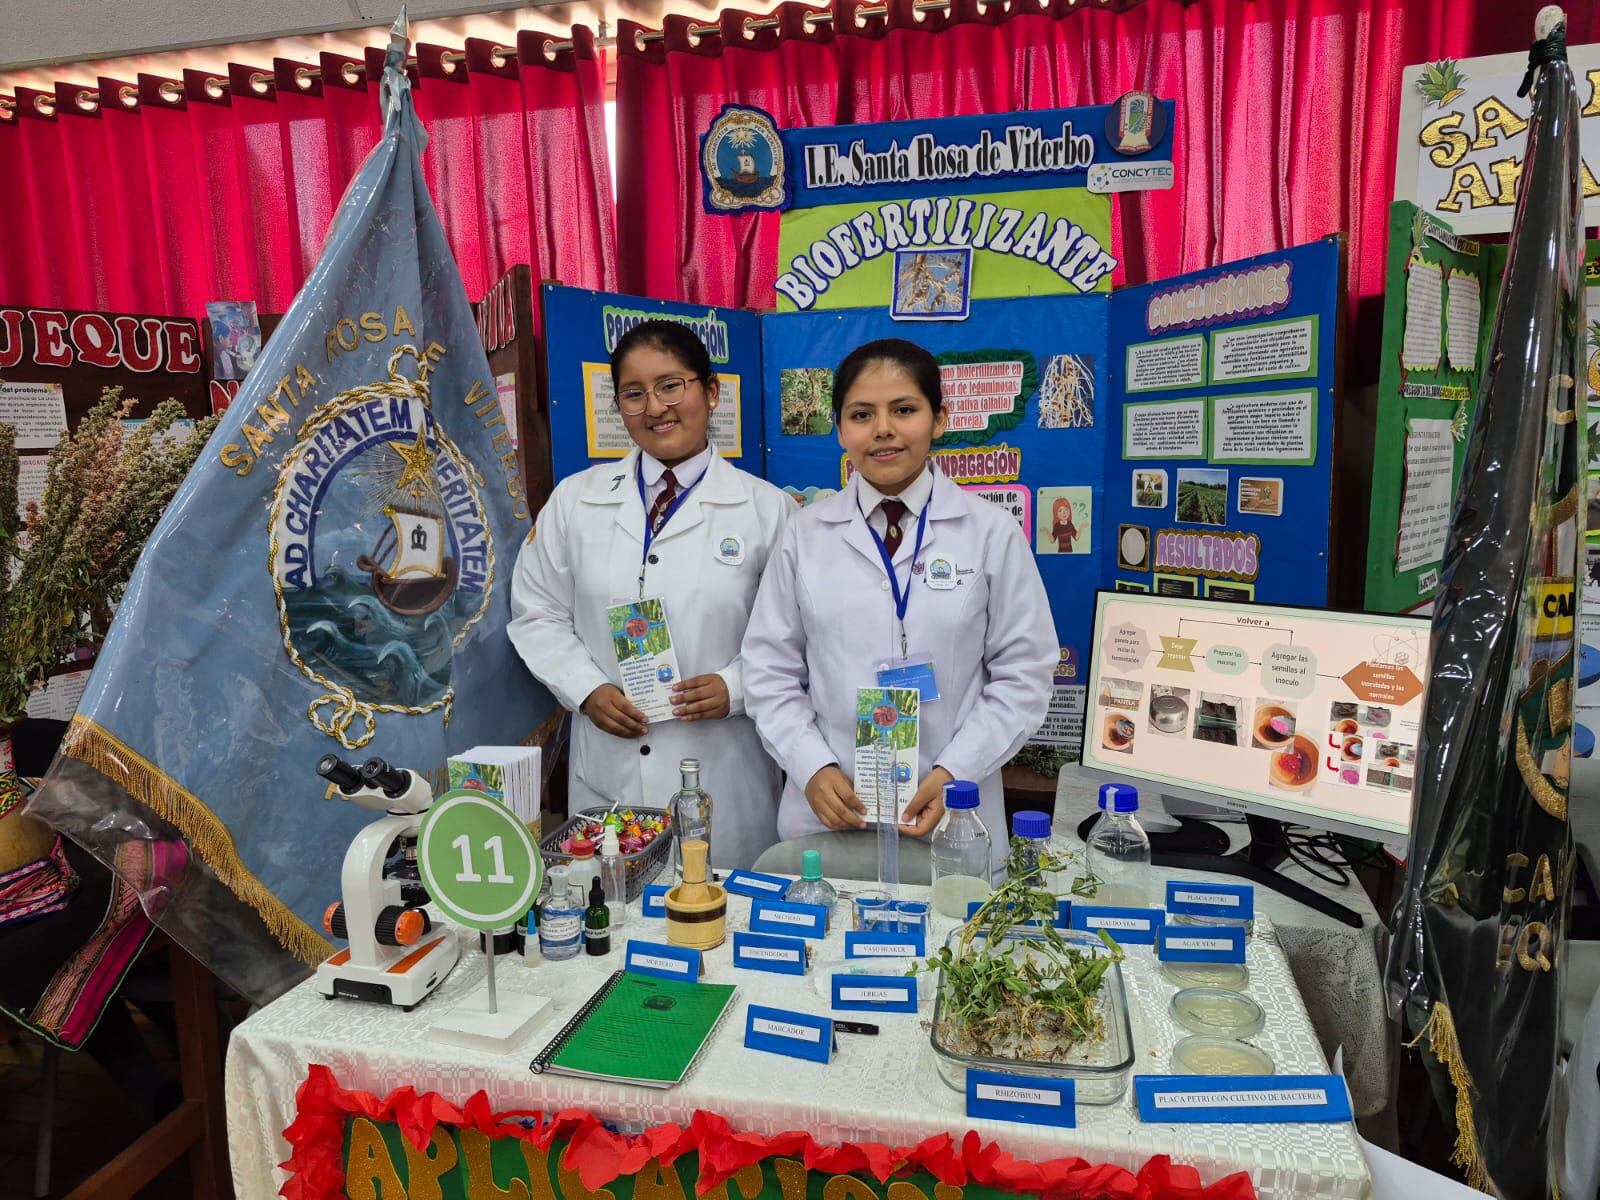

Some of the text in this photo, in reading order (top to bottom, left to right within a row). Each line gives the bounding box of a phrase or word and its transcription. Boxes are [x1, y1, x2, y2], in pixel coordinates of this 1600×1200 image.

[807, 122, 1093, 187] I.E. Santa Rosa de Viterbo
[1112, 166, 1172, 179] CONCYTEC
[778, 199, 1117, 311] BIOFERTILIZANTE
[1149, 263, 1291, 330] CONCLUSIONES
[957, 363, 1010, 378] biofertilizante
[1012, 363, 1022, 376] en
[14, 386, 48, 394] problema
[958, 382, 967, 394] de
[956, 397, 979, 411] sativa
[219, 364, 317, 477] SANTA
[286, 397, 414, 537] CHARITATEM
[1006, 491, 1018, 503] de
[1011, 505, 1023, 517] de
[1156, 532, 1258, 576] RESULTADOS
[285, 543, 310, 590] AD
[1236, 616, 1271, 627] Volver a
[1213, 649, 1233, 658] Preparar
[1271, 651, 1308, 663] Agregar las
[1271, 664, 1306, 675] semillas al
[1275, 676, 1300, 687] inoculo
[451, 834, 515, 885] 11
[767, 1023, 805, 1036] MARCADOR
[995, 1088, 1041, 1101] RHIZOBIUM
[1159, 1091, 1322, 1104] PLACA PETRI CON CULTIVO DE BACTERIA
